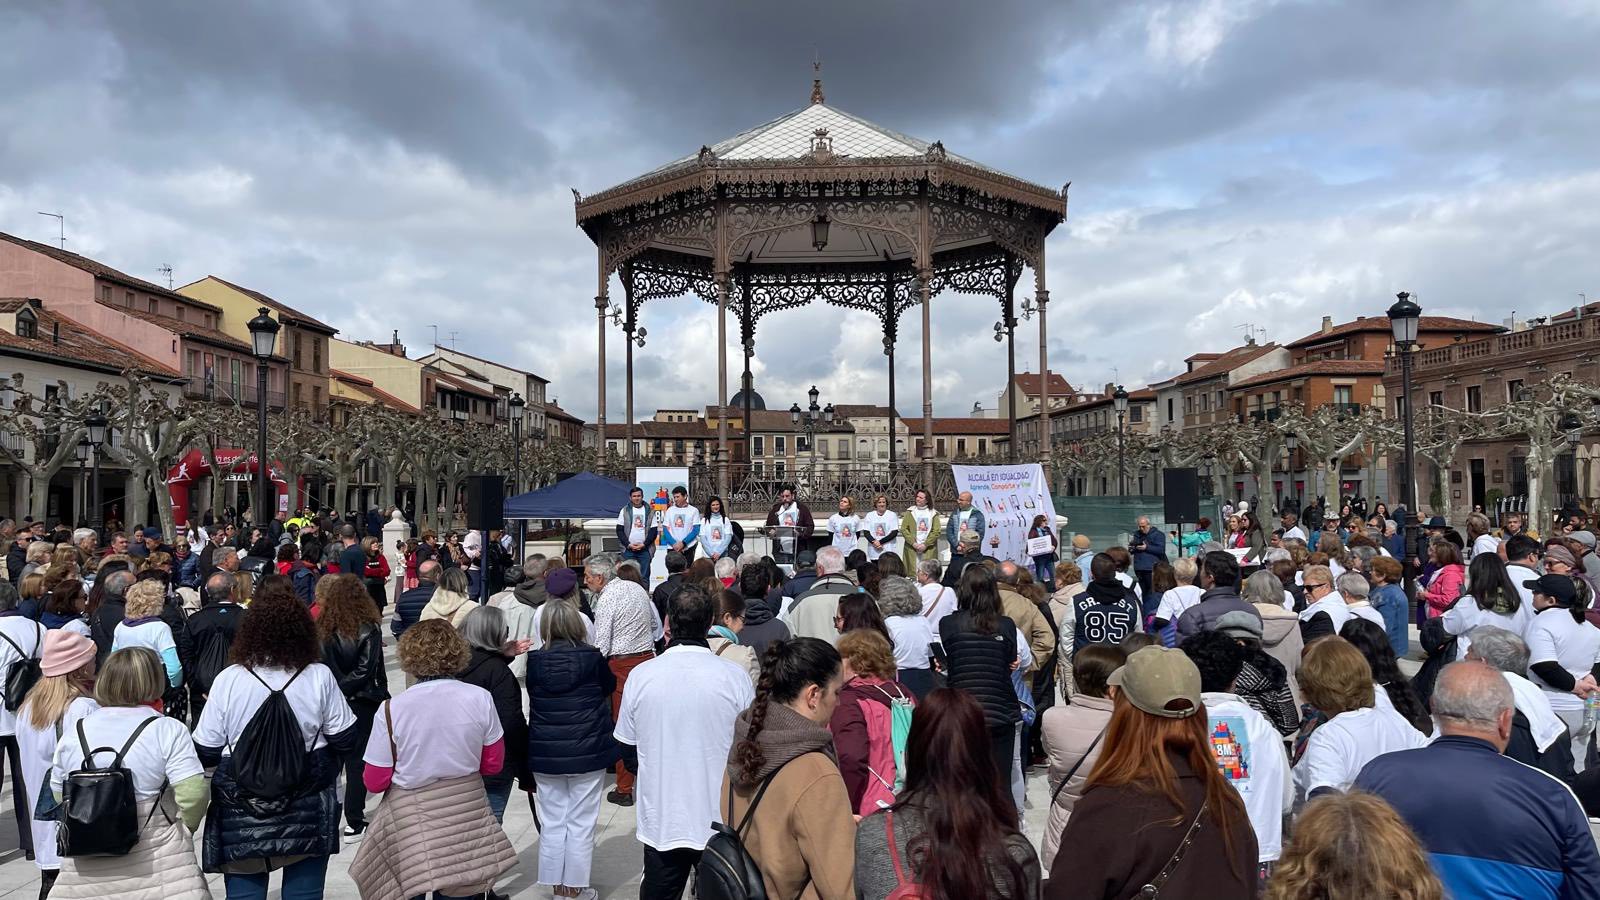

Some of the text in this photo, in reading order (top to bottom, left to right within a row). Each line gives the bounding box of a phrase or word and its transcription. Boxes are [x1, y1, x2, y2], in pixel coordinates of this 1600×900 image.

[968, 471, 990, 481] ALCALÁ
[1000, 471, 1030, 481] IGUALDAD
[1084, 611, 1130, 644] 85
[1217, 744, 1232, 755] 8M
